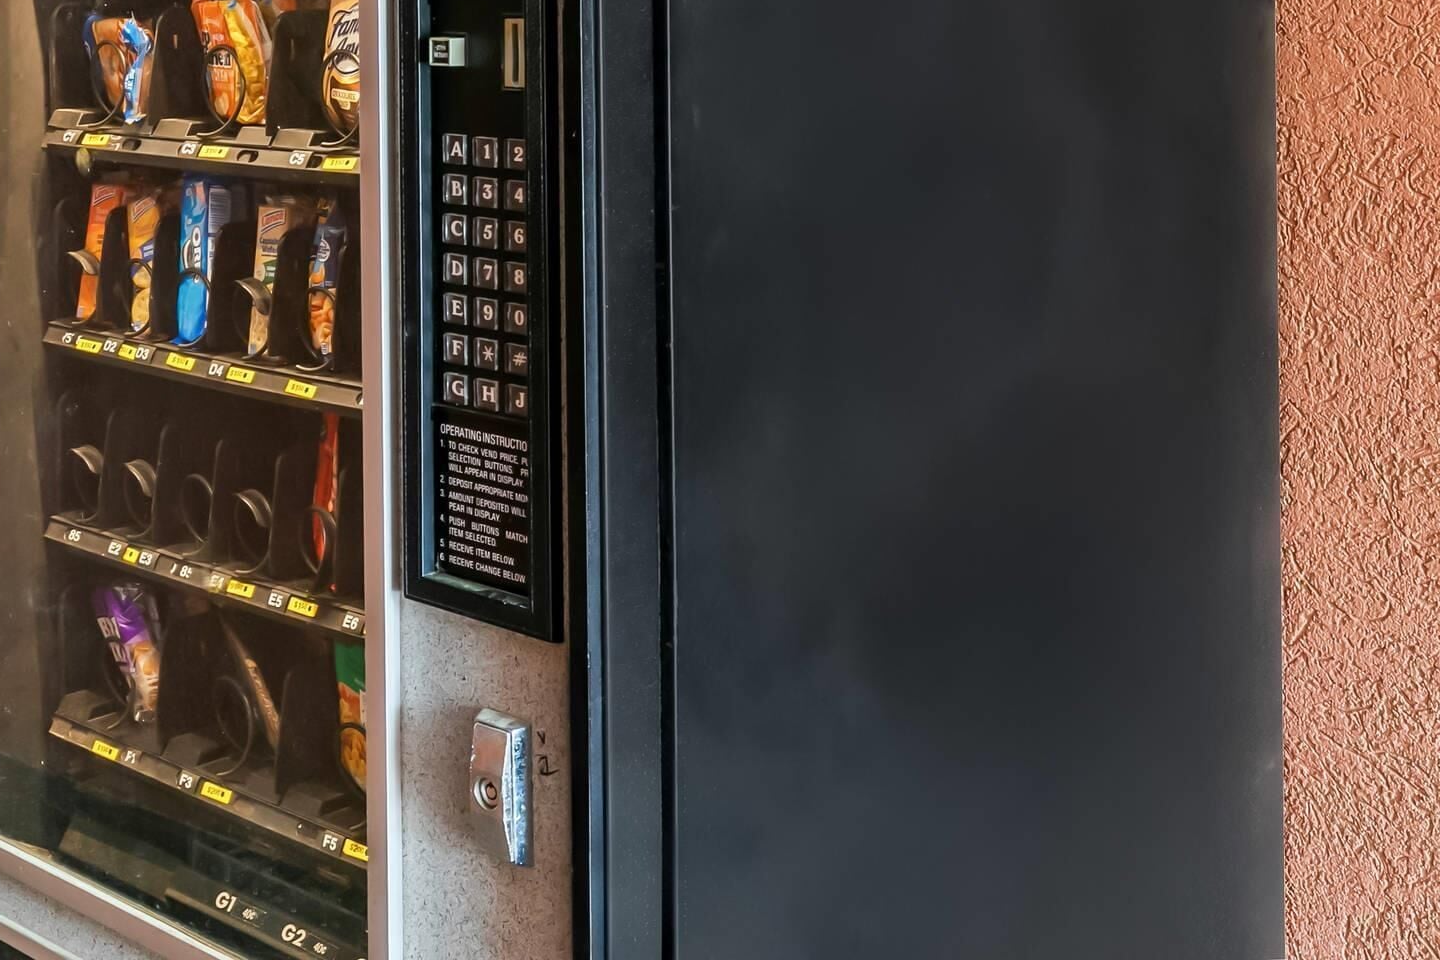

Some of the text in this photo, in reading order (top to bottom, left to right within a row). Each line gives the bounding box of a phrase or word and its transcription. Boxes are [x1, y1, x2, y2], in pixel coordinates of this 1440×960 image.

[181, 143, 196, 155] C3
[288, 152, 305, 165] C5
[450, 141, 524, 162] A 1 2
[451, 180, 524, 204] B 3 4
[450, 220, 524, 244] C 5 6
[451, 260, 525, 285] D 7 8
[452, 300, 525, 326] E 9 0
[452, 340, 464, 356] F
[512, 352, 528, 367] #
[208, 363, 225, 377] D4
[451, 380, 525, 408] G H J
[440, 424, 528, 452] OPERATING INSTRUCTIO
[448, 441, 456, 450] TO
[458, 443, 479, 455] CHECK
[481, 448, 498, 459] VEND
[448, 452, 481, 467] SELECTION
[448, 463, 463, 474] WILL
[464, 467, 488, 480] APPEAR
[489, 472, 496, 481] IN
[448, 476, 473, 490] DEPOSIT
[474, 483, 514, 500] APPROPRIATE
[448, 491, 474, 504] AMOUNT
[476, 498, 510, 513] DEPOSITED
[511, 506, 527, 518] WILL
[448, 501, 465, 513] PEAR
[466, 506, 473, 516] IN
[448, 515, 466, 527] PUSH
[471, 521, 500, 537] BUTTONS
[505, 530, 528, 544] MATCH
[448, 527, 464, 538] ITEM
[139, 551, 153, 565] E3
[448, 540, 474, 555] RECEIVE
[475, 548, 490, 560] ITEM
[448, 554, 474, 569] RECEIVE
[475, 562, 501, 577] CHANGE
[268, 592, 284, 608] E5
[342, 614, 359, 630] E6
[125, 750, 136, 764] F1
[179, 773, 193, 789] F3
[322, 834, 339, 851] F5
[215, 891, 237, 913] G1
[281, 923, 307, 947] G2
